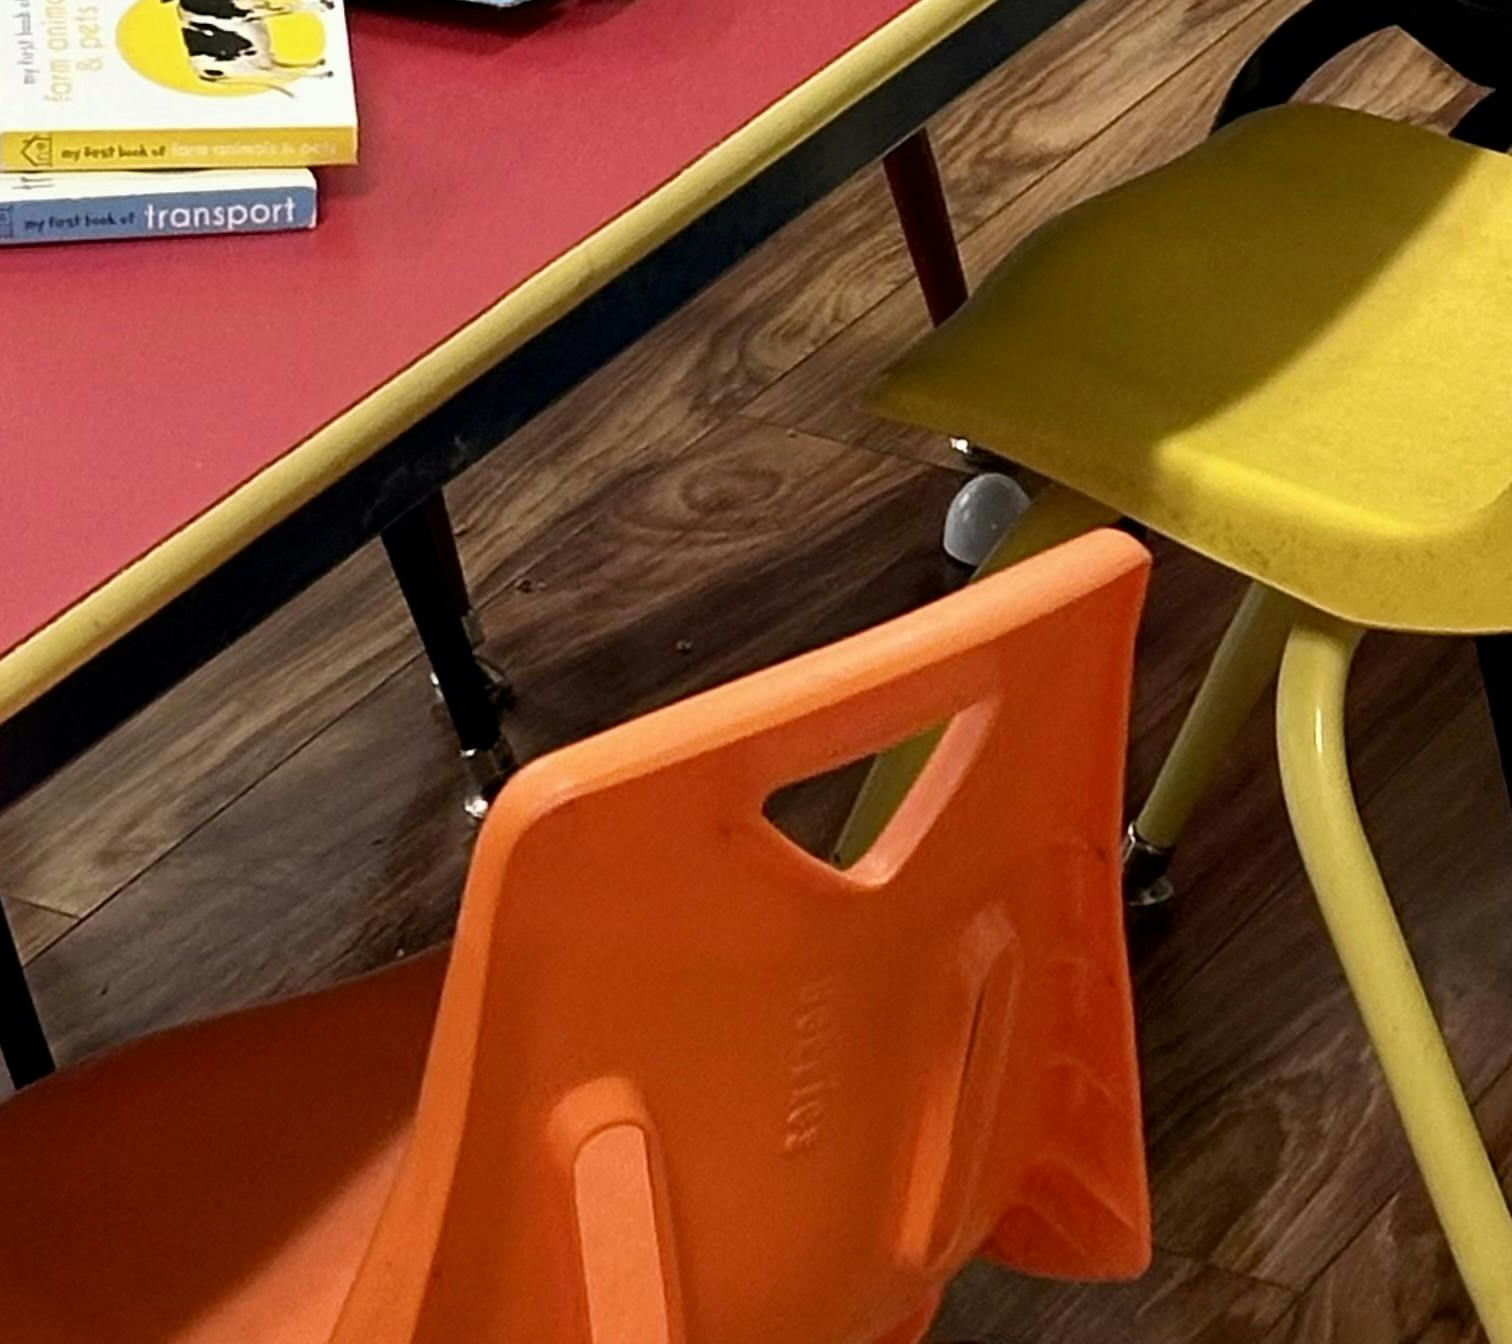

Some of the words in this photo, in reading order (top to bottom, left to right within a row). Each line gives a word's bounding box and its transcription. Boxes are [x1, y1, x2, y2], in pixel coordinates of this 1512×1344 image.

[75, 5, 106, 50] pets
[23, 68, 40, 85] my
[75, 57, 104, 72] &
[43, 58, 73, 103] farm
[61, 149, 80, 162] my
[24, 219, 45, 232] my
[119, 211, 135, 224] of
[144, 196, 296, 230] transport
